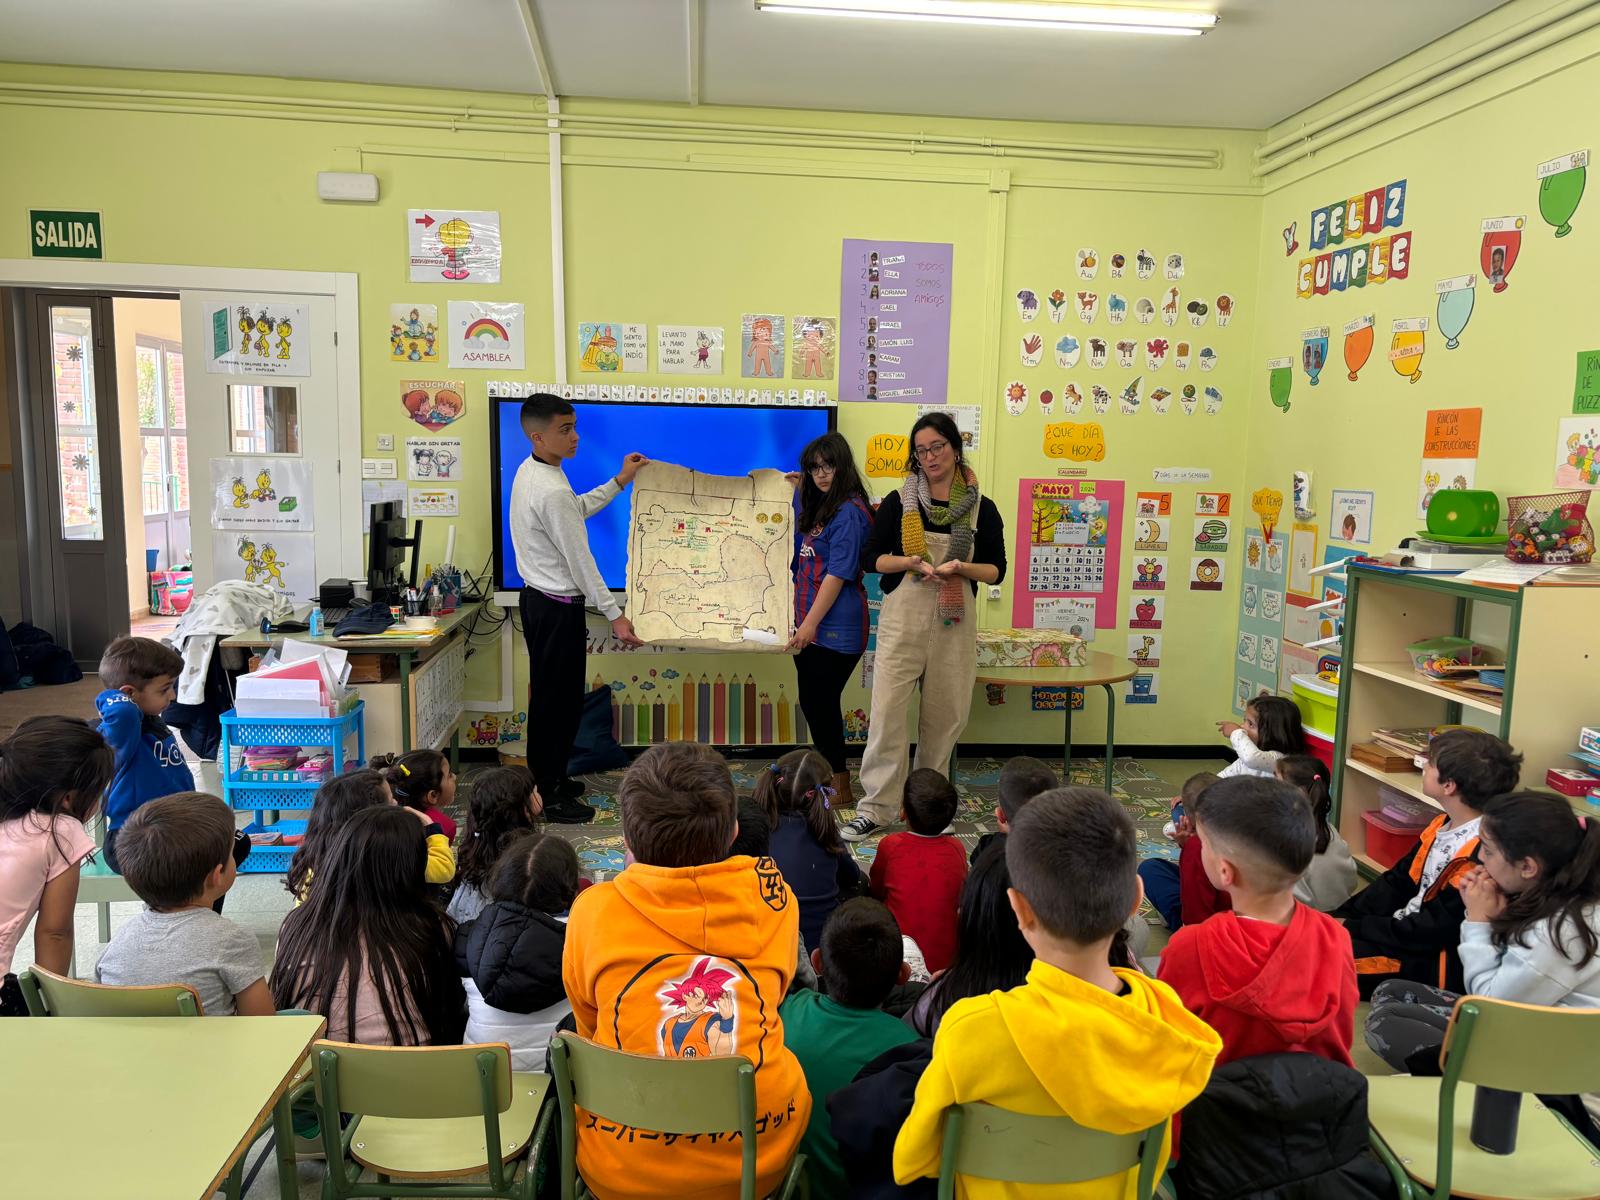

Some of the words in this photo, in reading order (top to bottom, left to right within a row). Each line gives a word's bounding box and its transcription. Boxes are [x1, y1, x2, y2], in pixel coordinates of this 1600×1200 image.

[1540, 162, 1561, 174] JULIO
[1313, 188, 1402, 242] FELIZ
[1483, 220, 1503, 229] JUNIO
[36, 221, 98, 249] SALIDA
[1299, 237, 1408, 291] CUMPLE
[861, 268, 866, 279] 2
[861, 284, 866, 295] 3
[916, 280, 941, 288] SOMOS
[1437, 280, 1452, 289] MAYO
[861, 300, 866, 313] 4
[861, 317, 865, 330] 5
[859, 337, 865, 347] 6
[463, 353, 511, 363] ASAMBLEA
[859, 353, 865, 362] 7
[1587, 357, 1600, 371] RIN
[858, 369, 864, 380] 8
[1583, 376, 1591, 388] DE
[1577, 395, 1600, 410] PUZZ
[1446, 425, 1458, 435] LAS
[874, 438, 905, 451] HOY
[1050, 444, 1064, 454] ES
[868, 458, 904, 472] SOMO
[1154, 471, 1159, 479] 7
[1042, 485, 1070, 495] MAYO
[1160, 494, 1169, 511] 5
[1219, 495, 1229, 513] 2
